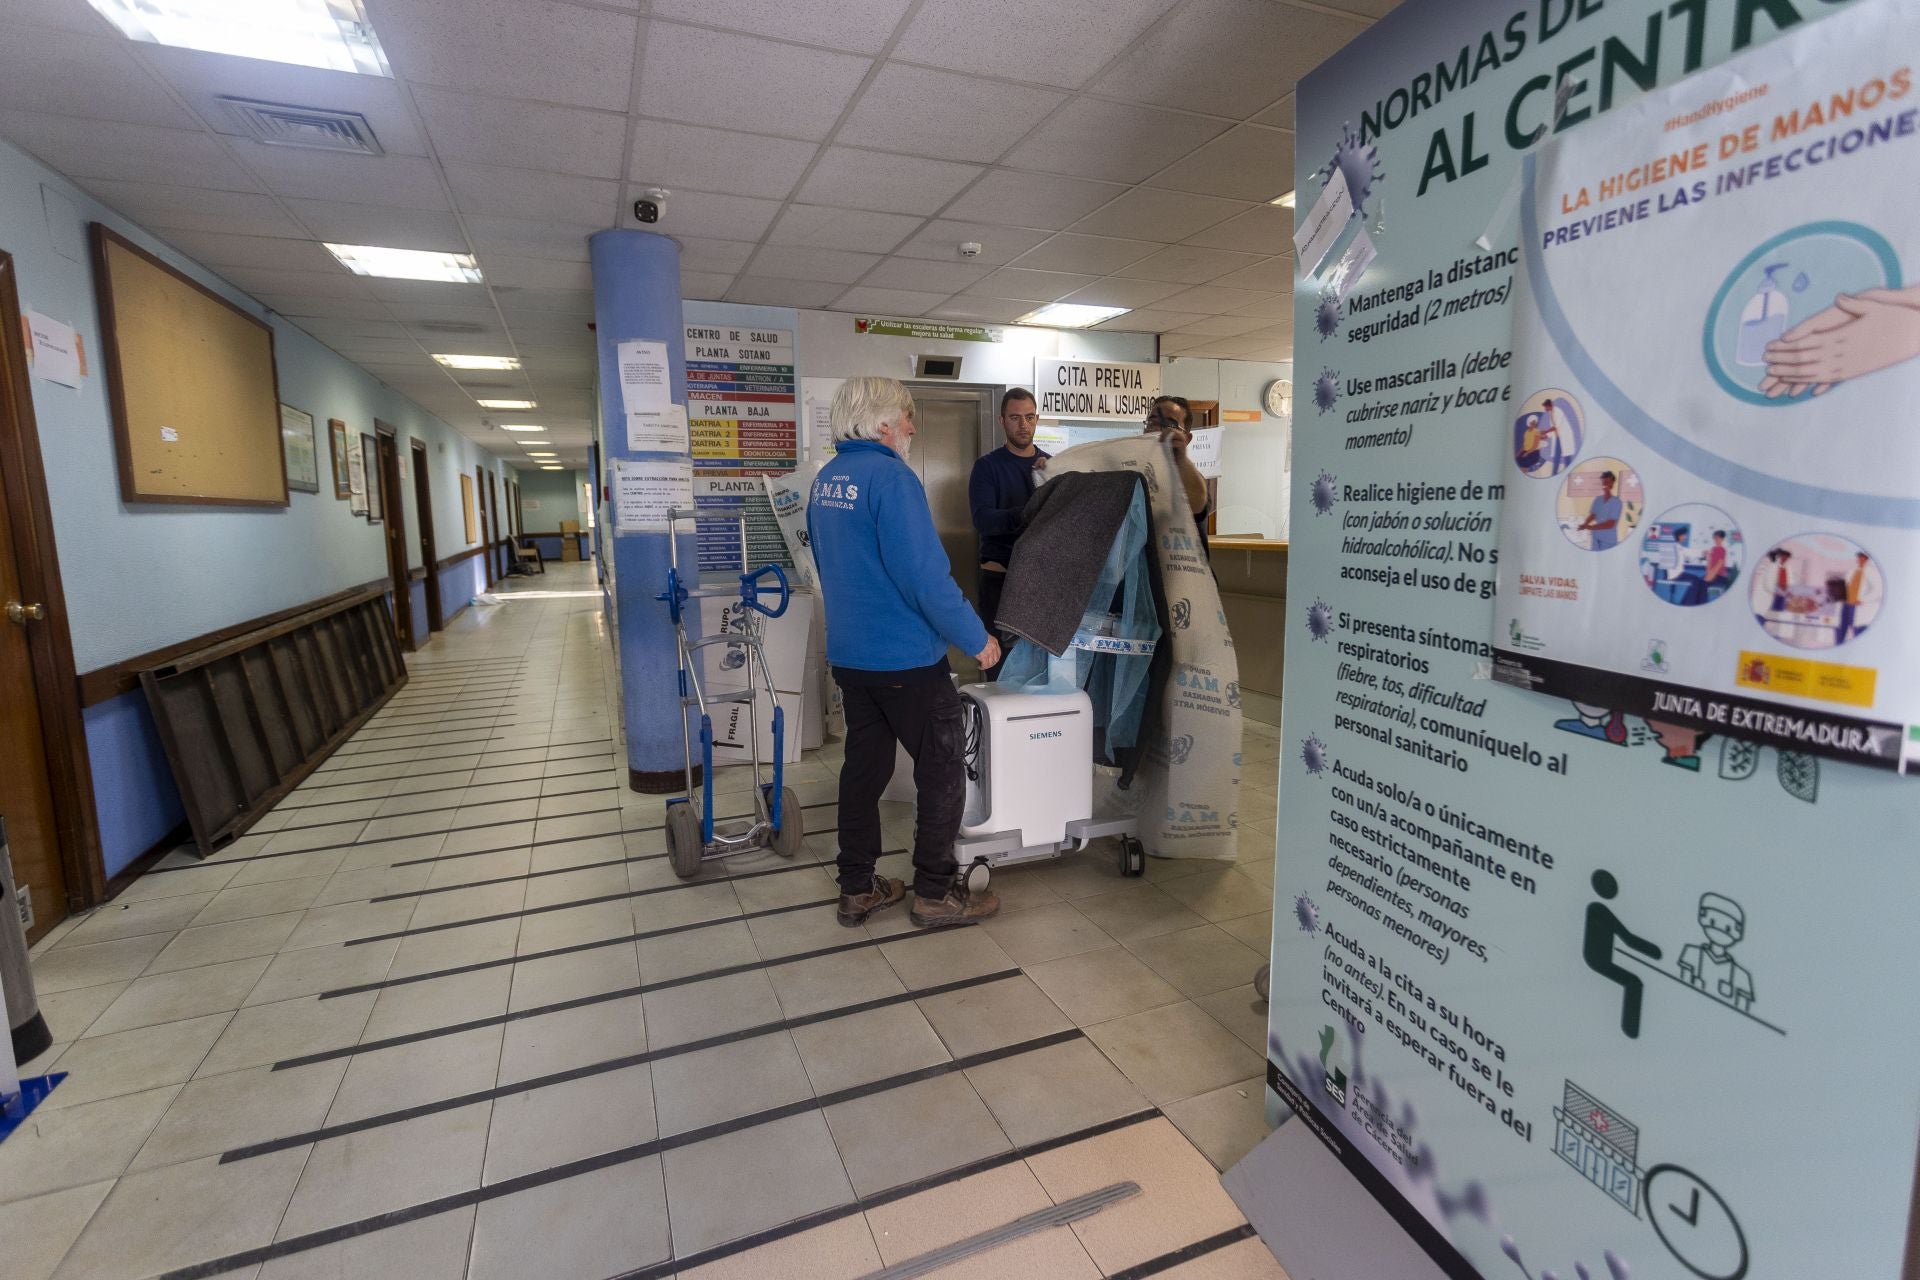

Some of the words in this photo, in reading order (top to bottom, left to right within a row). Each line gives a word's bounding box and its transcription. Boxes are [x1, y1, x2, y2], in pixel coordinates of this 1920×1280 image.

[1360, 11, 1527, 147] NORMAS
[1416, 111, 1490, 198] AL
[1504, 0, 1804, 151] CENTR
[1664, 84, 1768, 132] #HandHygiene
[1562, 187, 1590, 214] LA
[1599, 144, 1708, 202] HIGIENE
[1718, 124, 1760, 161] DE
[1770, 69, 1911, 141] MANOS
[1543, 199, 1650, 249] PREVIENE
[1658, 181, 1707, 213] LAS
[1716, 108, 1919, 195] INFECCIONE
[1348, 305, 1420, 343] seguridad
[1423, 299, 1443, 326] (2
[1442, 276, 1512, 318] metros)
[1349, 279, 1424, 315] Mantenga
[1428, 270, 1443, 290] la
[687, 328, 720, 340] CENTRO
[730, 331, 740, 341] DE
[751, 332, 778, 343] SALUD
[881, 320, 902, 328] Utilizar
[913, 323, 937, 331] escaleras
[911, 330, 932, 338] mejora
[696, 347, 729, 358] PLANTA
[739, 350, 770, 360] SOTANO
[745, 385, 787, 393] VETERINARIOS
[1058, 366, 1088, 386] CITA
[1095, 367, 1142, 389] PREVIA
[1347, 379, 1371, 396] Use
[1375, 359, 1456, 392] mascarilla
[705, 405, 738, 416] PLANTA
[748, 407, 769, 416] BAJA
[1042, 392, 1093, 413] ATENCION
[1098, 394, 1111, 414] AL
[1346, 401, 1399, 423] cubrirse
[1400, 392, 1440, 418] nariz
[1440, 394, 1453, 414] y
[1454, 386, 1498, 408] boca
[1345, 424, 1413, 450] momento)
[710, 482, 755, 491] PLANTA
[821, 483, 858, 500] MAS
[1343, 484, 1393, 502] Realice
[1397, 482, 1456, 505] higiene
[1460, 480, 1483, 500] de
[1343, 510, 1368, 530] (con
[1368, 511, 1409, 532] jabón
[1411, 516, 1421, 530] o
[1423, 511, 1492, 532] solución
[1342, 536, 1453, 563] hidroalcohólica).
[1458, 542, 1485, 563] No
[1341, 566, 1400, 587] aconseja
[1403, 568, 1418, 586] el
[1421, 574, 1450, 590] uso
[1454, 572, 1476, 593] de
[1520, 574, 1545, 586] SALVA
[1338, 613, 1350, 629] Si
[1352, 617, 1415, 643] presenta
[1338, 640, 1429, 674] respiratorios
[1337, 661, 1378, 690] (fiebre,
[1382, 676, 1405, 698] tos,
[1408, 681, 1488, 718] dificultad
[728, 706, 739, 740] FRAGIL
[1029, 730, 1062, 740] SIEMENS
[1335, 713, 1392, 746] personal
[1395, 734, 1469, 773] sanitario
[1336, 690, 1417, 730] respiratoria),
[1420, 716, 1542, 767] comuníquelo
[1547, 753, 1568, 776] al
[1652, 691, 1700, 719] JUNTA
[1707, 702, 1727, 723] DE
[1731, 707, 1881, 755] EXTREMADURA
[1332, 759, 1374, 790] Acuda
[1376, 783, 1421, 812] solo/a
[1425, 803, 1435, 817] o
[1439, 804, 1554, 870] únicamente
[1330, 808, 1358, 834] caso
[1361, 825, 1471, 892] estrictamente
[1332, 784, 1354, 807] con
[1357, 798, 1387, 822] un/a
[1390, 812, 1506, 880] acompañante
[1510, 870, 1537, 895] en
[1330, 831, 1393, 877] necesario
[1396, 866, 1470, 919] (personas
[1327, 879, 1381, 921] personas
[1382, 914, 1450, 965] menores)
[1329, 855, 1415, 918] dependientes,
[1418, 909, 1489, 963] mayores,
[1322, 989, 1366, 1034] Centro
[1325, 922, 1366, 961] Acuda
[1368, 955, 1376, 968] a
[1379, 957, 1391, 979] la
[1394, 974, 1423, 1004] cita
[1427, 995, 1437, 1010] a
[1440, 1004, 1458, 1029] su
[1463, 1015, 1507, 1062] hora
[1324, 944, 1342, 969] (no
[1344, 963, 1385, 1001] antes).
[1388, 990, 1406, 1017] En
[1409, 1011, 1426, 1033] su
[1430, 1027, 1468, 1063] caso
[1472, 1056, 1492, 1080] se
[1496, 1069, 1515, 1098] le
[1323, 966, 1373, 1016] invitará
[1375, 1010, 1384, 1024] a
[1386, 1016, 1445, 1073] esperar
[1449, 1059, 1496, 1115] fuera
[1501, 1108, 1532, 1143] del
[1326, 1077, 1345, 1104] SES
[1353, 1085, 1394, 1129] Gerencia
[1397, 1128, 1412, 1146] del
[1352, 1111, 1362, 1126] de
[1364, 1122, 1403, 1165] Cáceres
[1376, 1122, 1388, 1137] de
[1391, 1133, 1418, 1165] Salud
